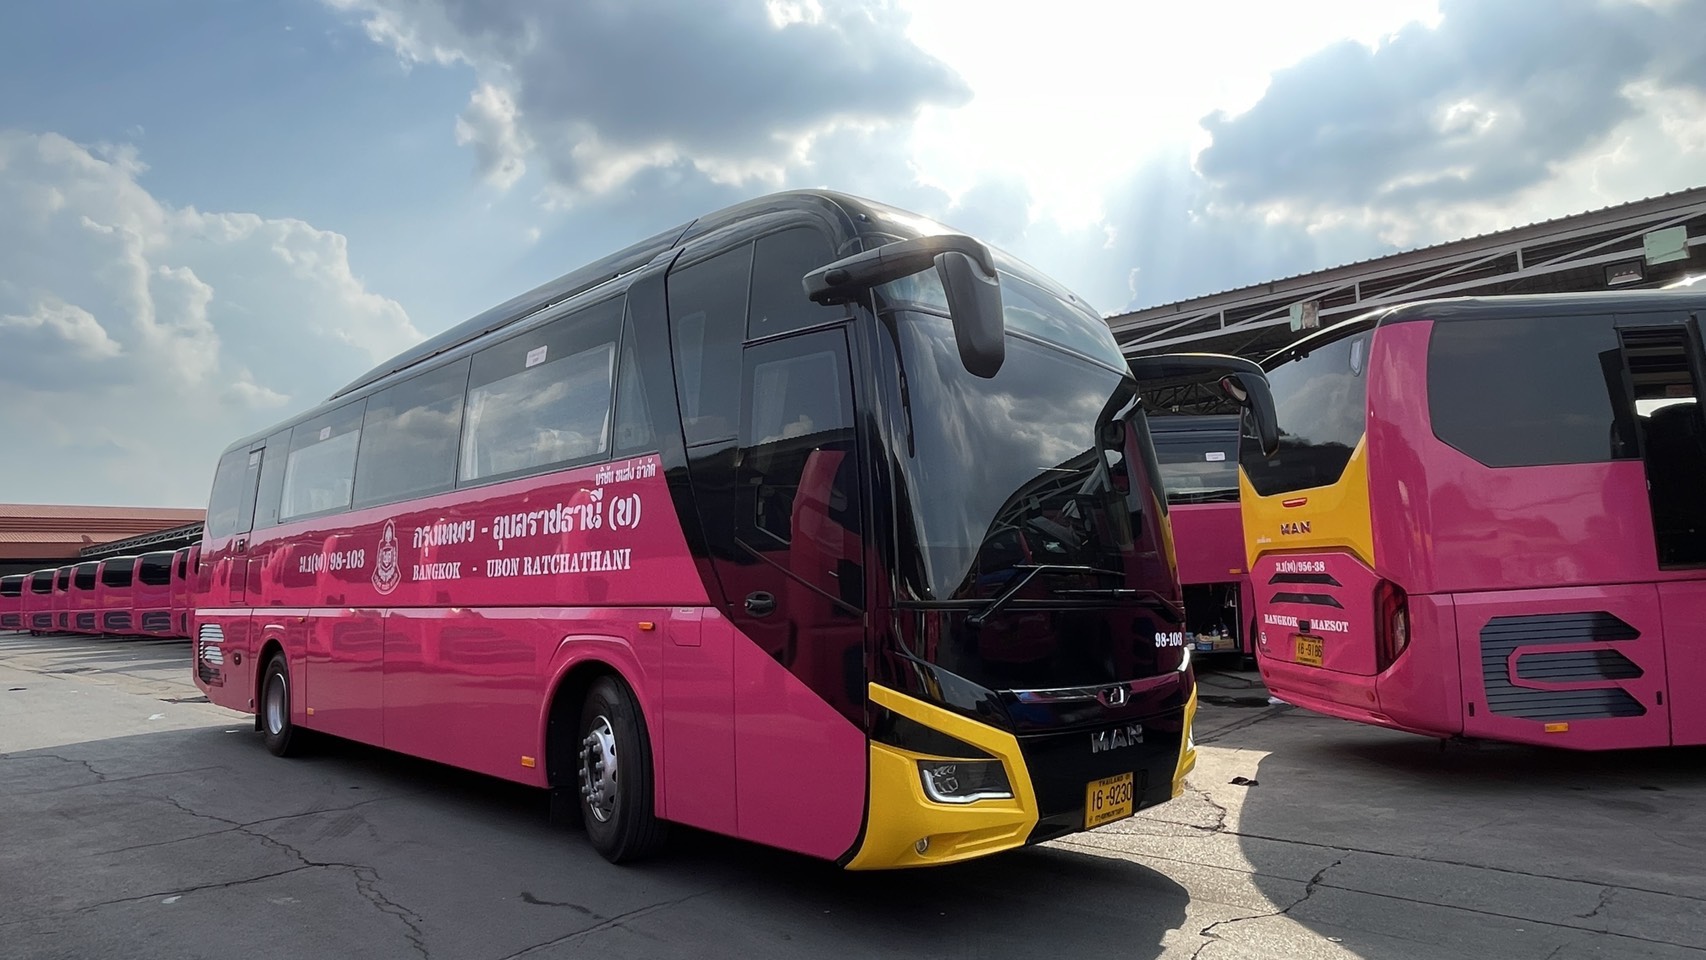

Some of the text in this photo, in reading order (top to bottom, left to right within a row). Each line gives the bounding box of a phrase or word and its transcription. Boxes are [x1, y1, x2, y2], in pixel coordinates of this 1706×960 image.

[412, 519, 476, 557] กรุงเทพฯ
[493, 487, 604, 551] อุบลราชธานี
[609, 493, 642, 531] (ข)
[1280, 520, 1311, 536] MAN
[412, 562, 462, 581] BANGKOK
[486, 557, 519, 578] UBON
[523, 548, 632, 576] RATCHATHANI
[1263, 613, 1349, 633] BANGKOK MAESOT
[1154, 631, 1183, 648] 98-103
[1091, 724, 1144, 754] MAN
